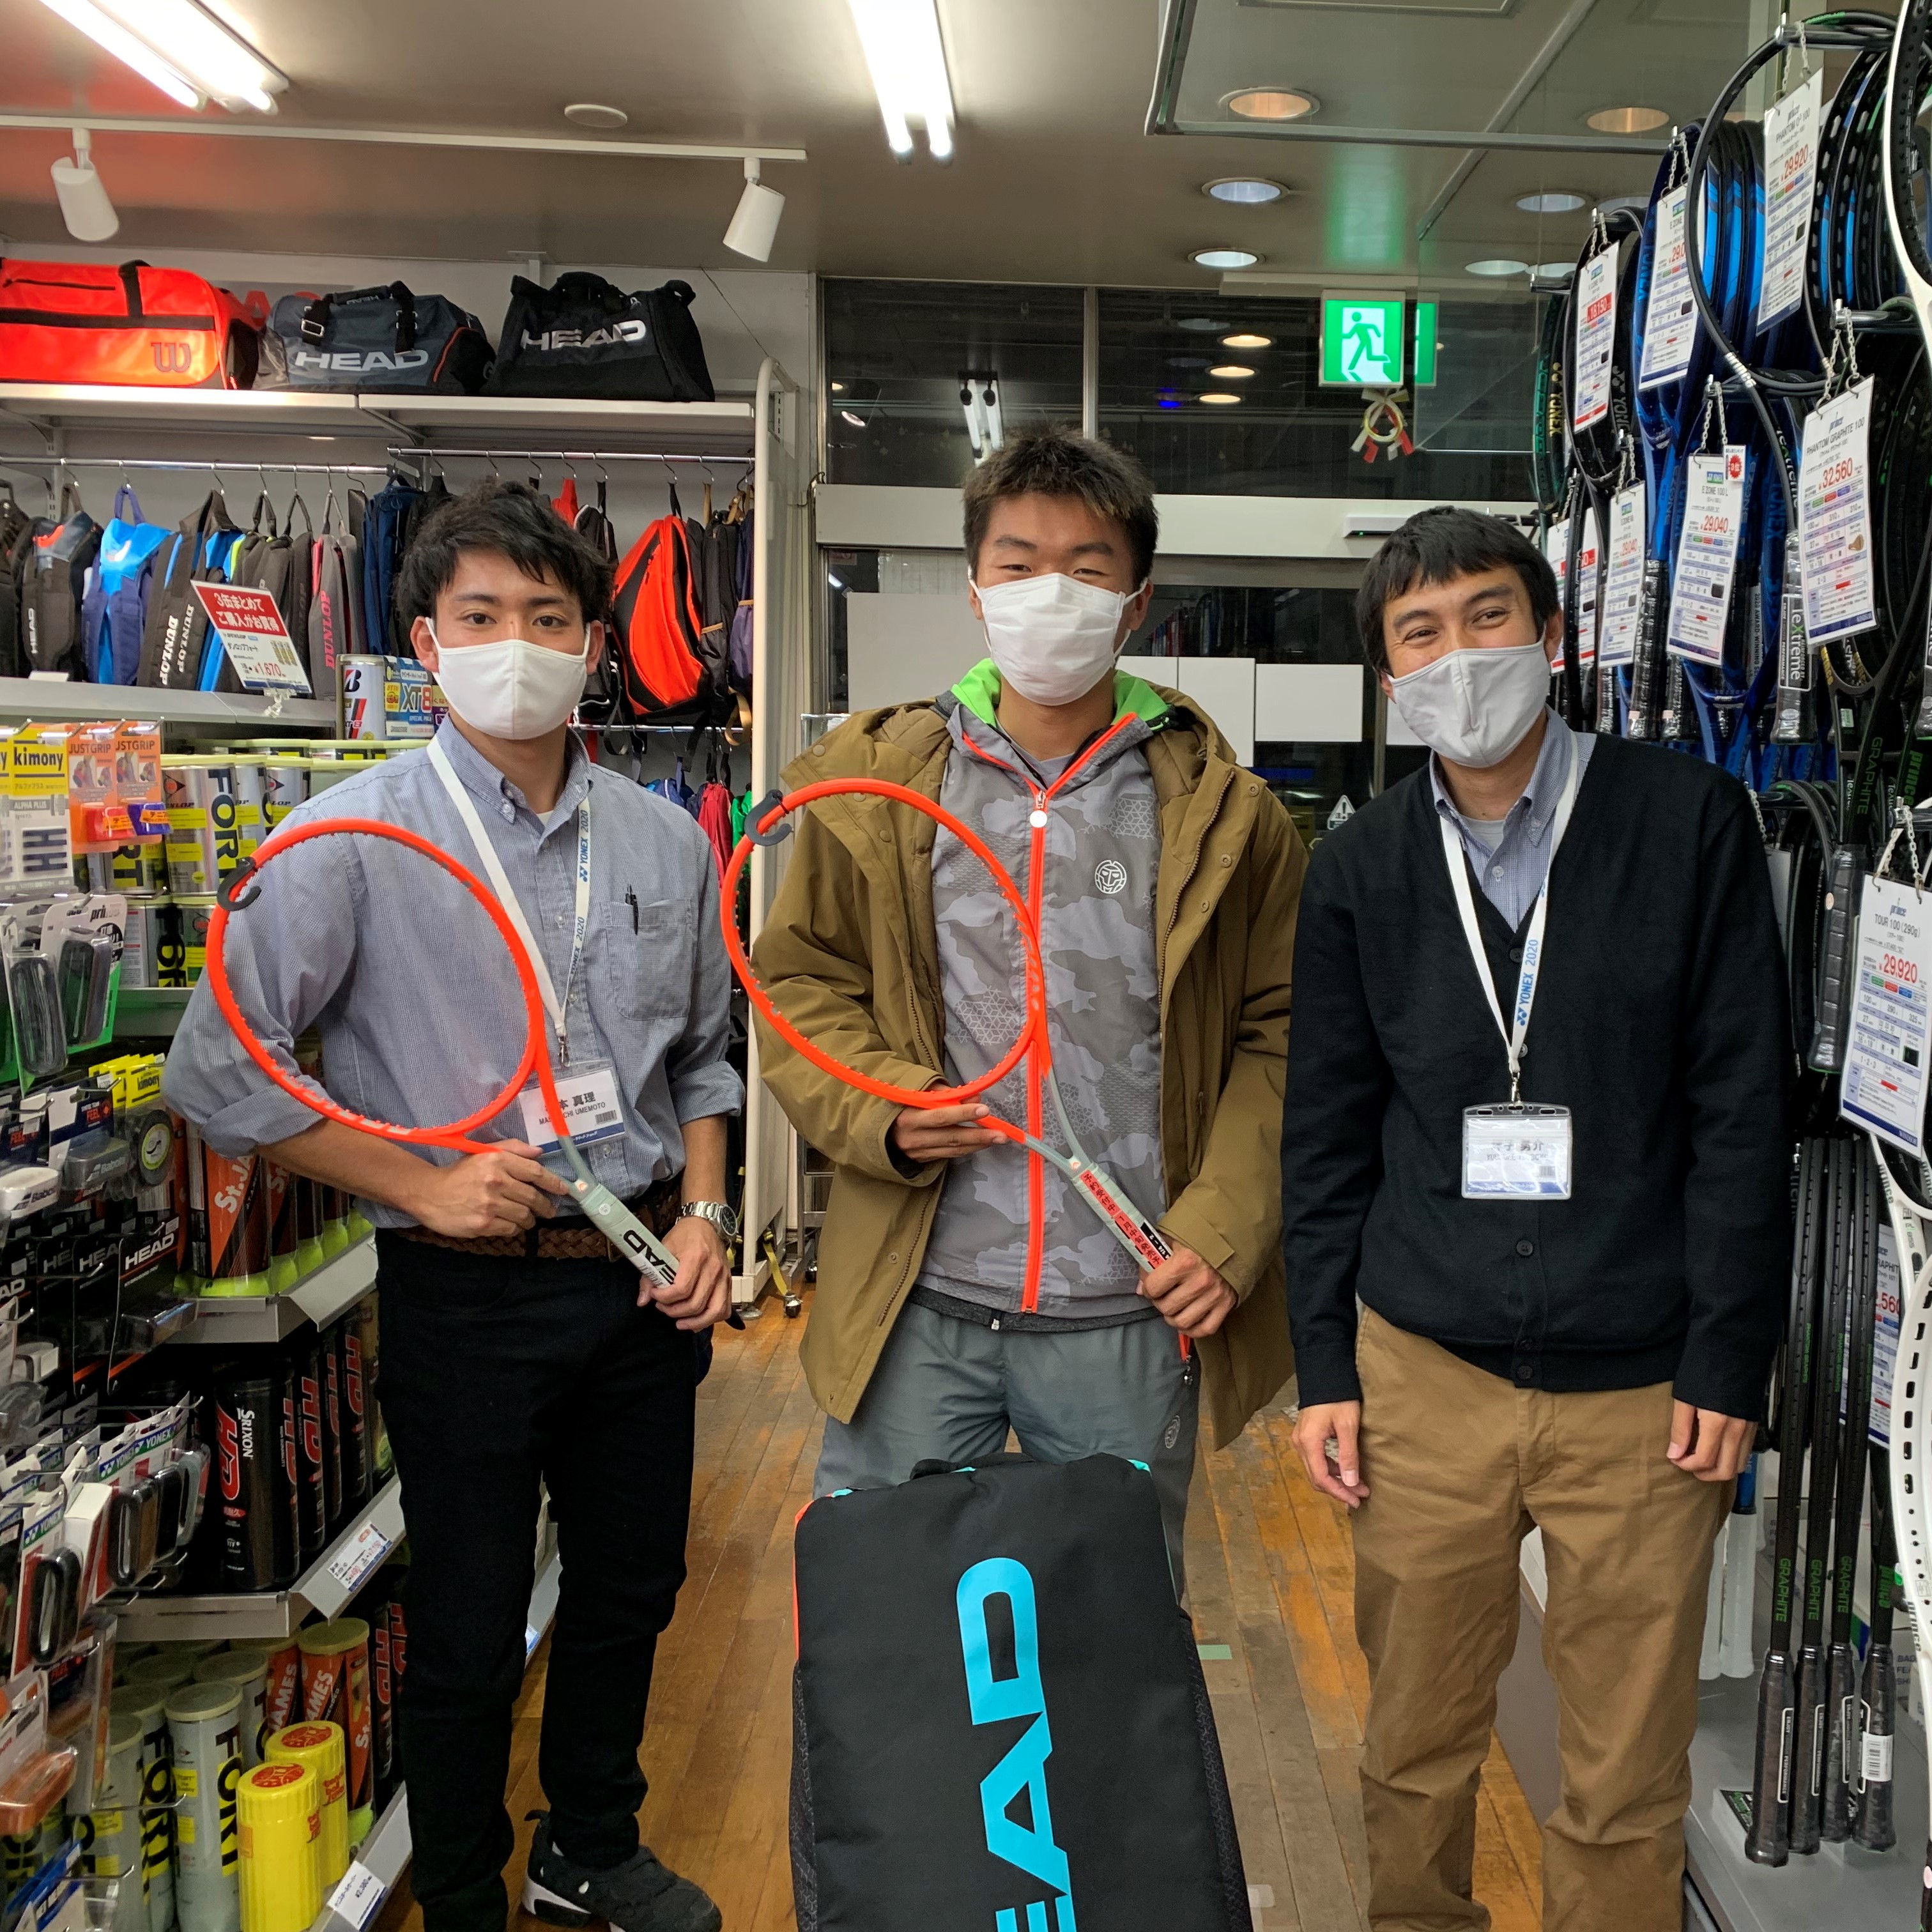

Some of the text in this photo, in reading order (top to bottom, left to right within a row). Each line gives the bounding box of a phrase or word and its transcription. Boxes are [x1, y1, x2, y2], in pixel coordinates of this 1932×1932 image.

[520, 320, 647, 350] HEAD
[295, 349, 429, 372] HEAD
[1807, 438, 1829, 456] PHANTOM
[1830, 424, 1853, 444] GRAPHITE
[214, 593, 264, 612] 3缶まとめて
[28, 608, 38, 654] HEAD
[178, 604, 194, 673] DUNLOP
[216, 611, 280, 632] ご購入がお買得
[320, 590, 335, 670] DUNLOP
[160, 615, 178, 685] DUNLOP
[400, 684, 433, 712] XT8
[13, 746, 63, 771] kimony
[69, 743, 111, 755] JUSTGRIP
[1857, 737, 1883, 815] GRAPHITE
[579, 810, 589, 864] YONEX 2020
[1874, 914, 1889, 926] TOUR
[1890, 917, 1900, 931] 100
[571, 916, 585, 975] YONEX 2020
[1519, 939, 1538, 1005] YONEX 2020
[572, 1091, 596, 1107] 真理
[576, 1101, 606, 1115] UMEMOTO
[1084, 1174, 1116, 1211] 予約受付中
[80, 1243, 119, 1271] HEA
[125, 1233, 174, 1270] HEAD
[624, 1230, 677, 1285] EAD
[146, 1427, 172, 1447] YONEX
[240, 1408, 255, 1459] SRIXON
[1775, 1558, 1791, 1623] GRAPHITE
[1808, 1559, 1822, 1621] GRAPHITE
[1837, 1556, 1853, 1614] GRAPHITE
